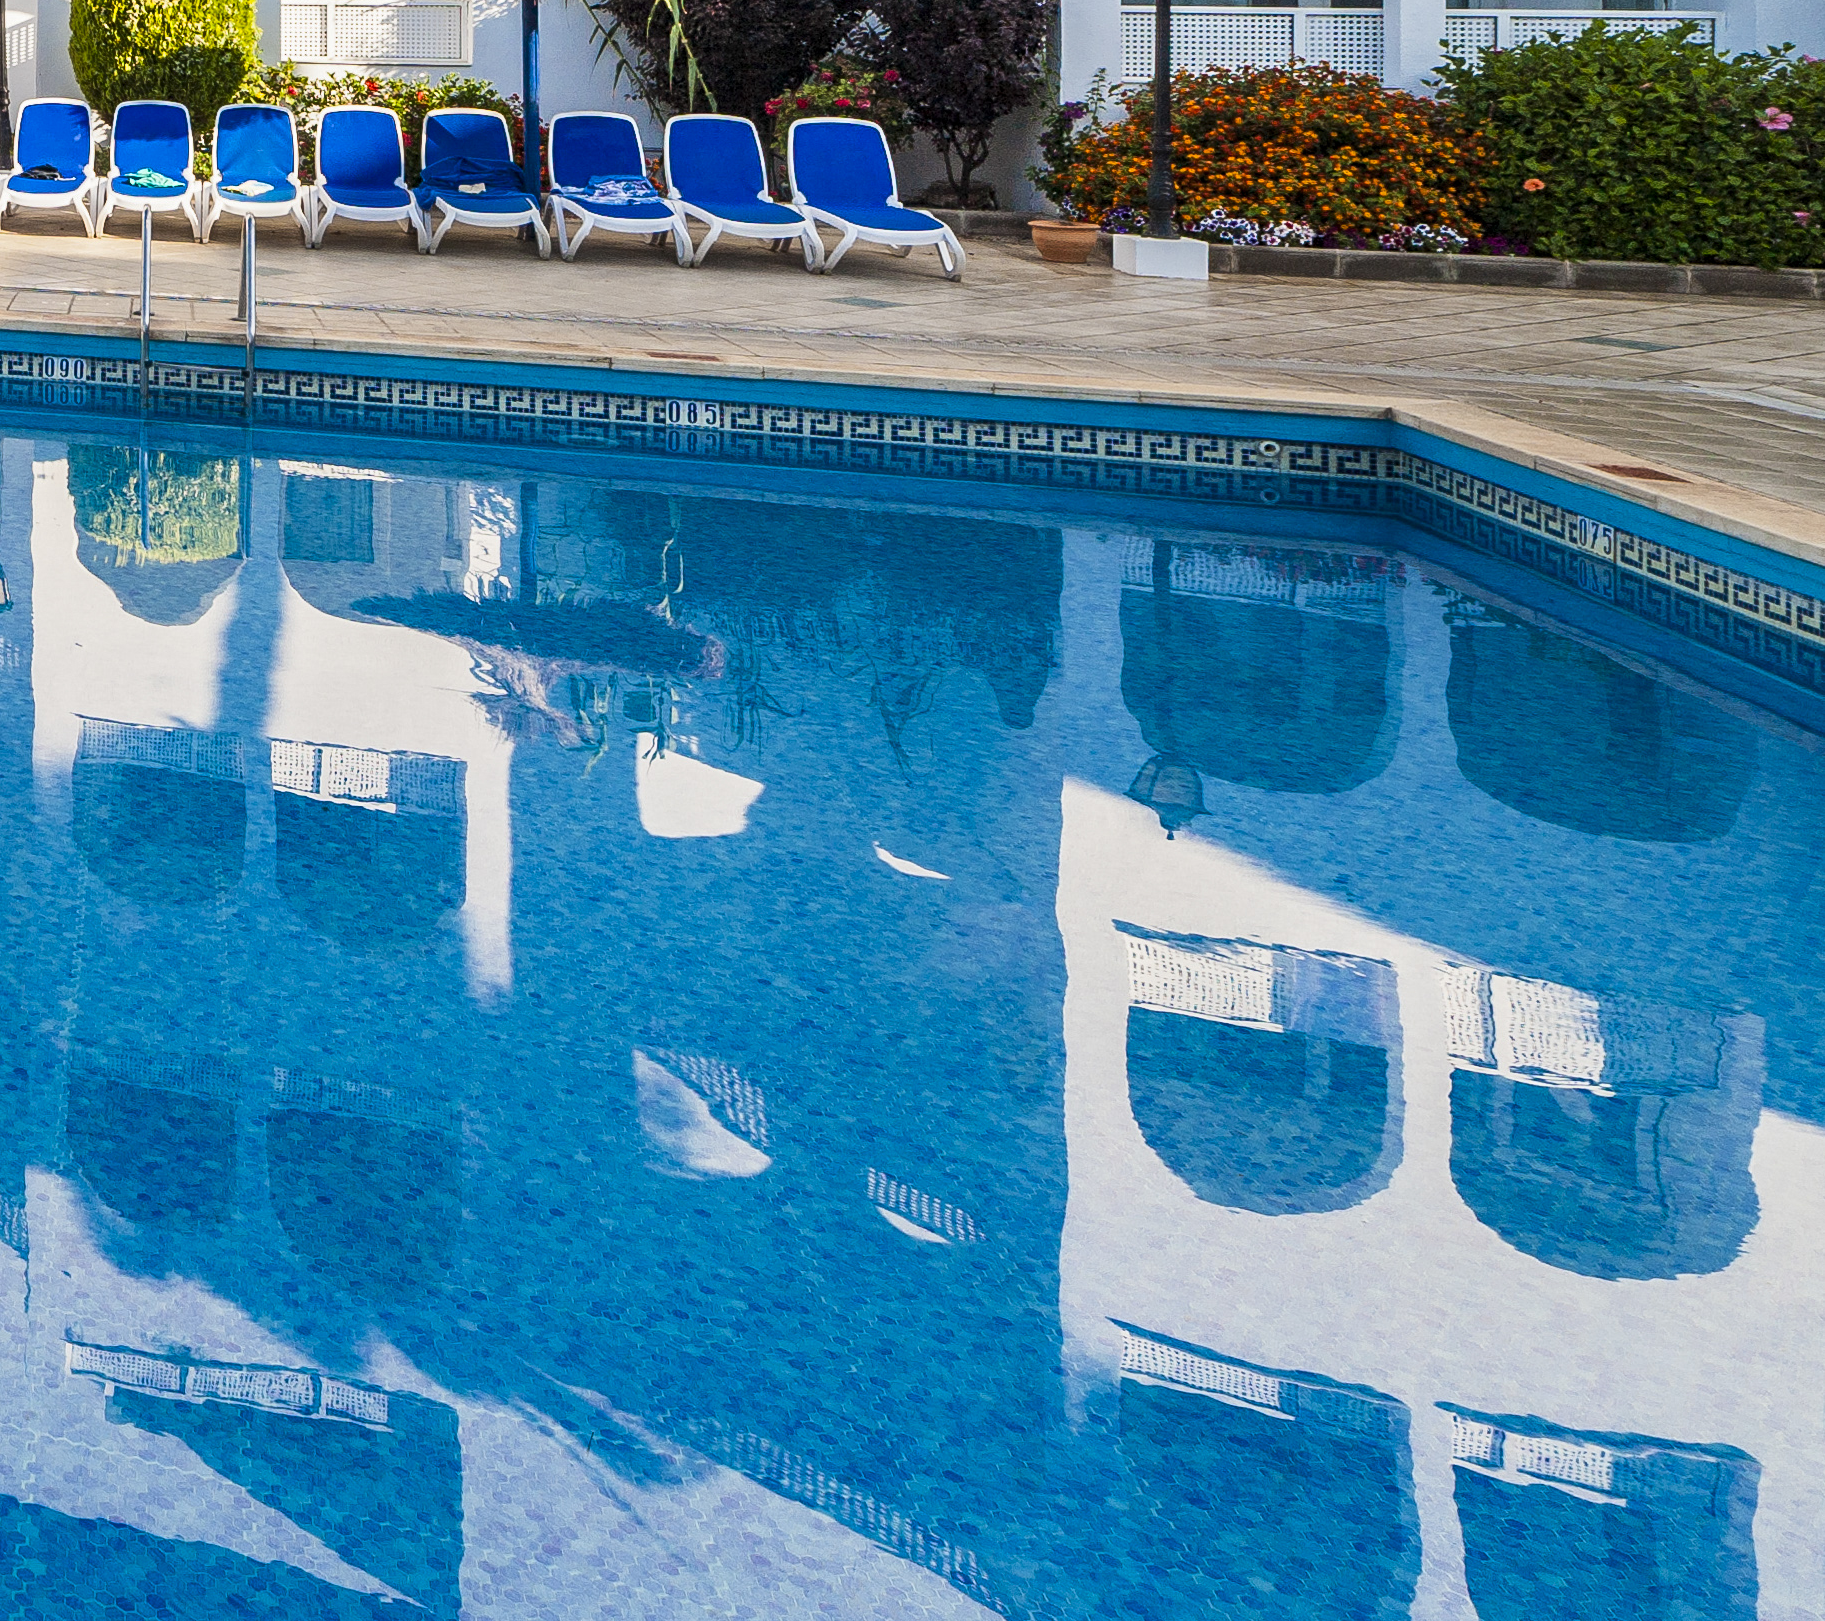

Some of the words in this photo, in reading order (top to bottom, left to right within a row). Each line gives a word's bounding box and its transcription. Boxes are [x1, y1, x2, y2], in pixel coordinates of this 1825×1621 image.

[44, 357, 84, 379] 090
[668, 400, 717, 425] 085
[1579, 518, 1612, 555] 075
